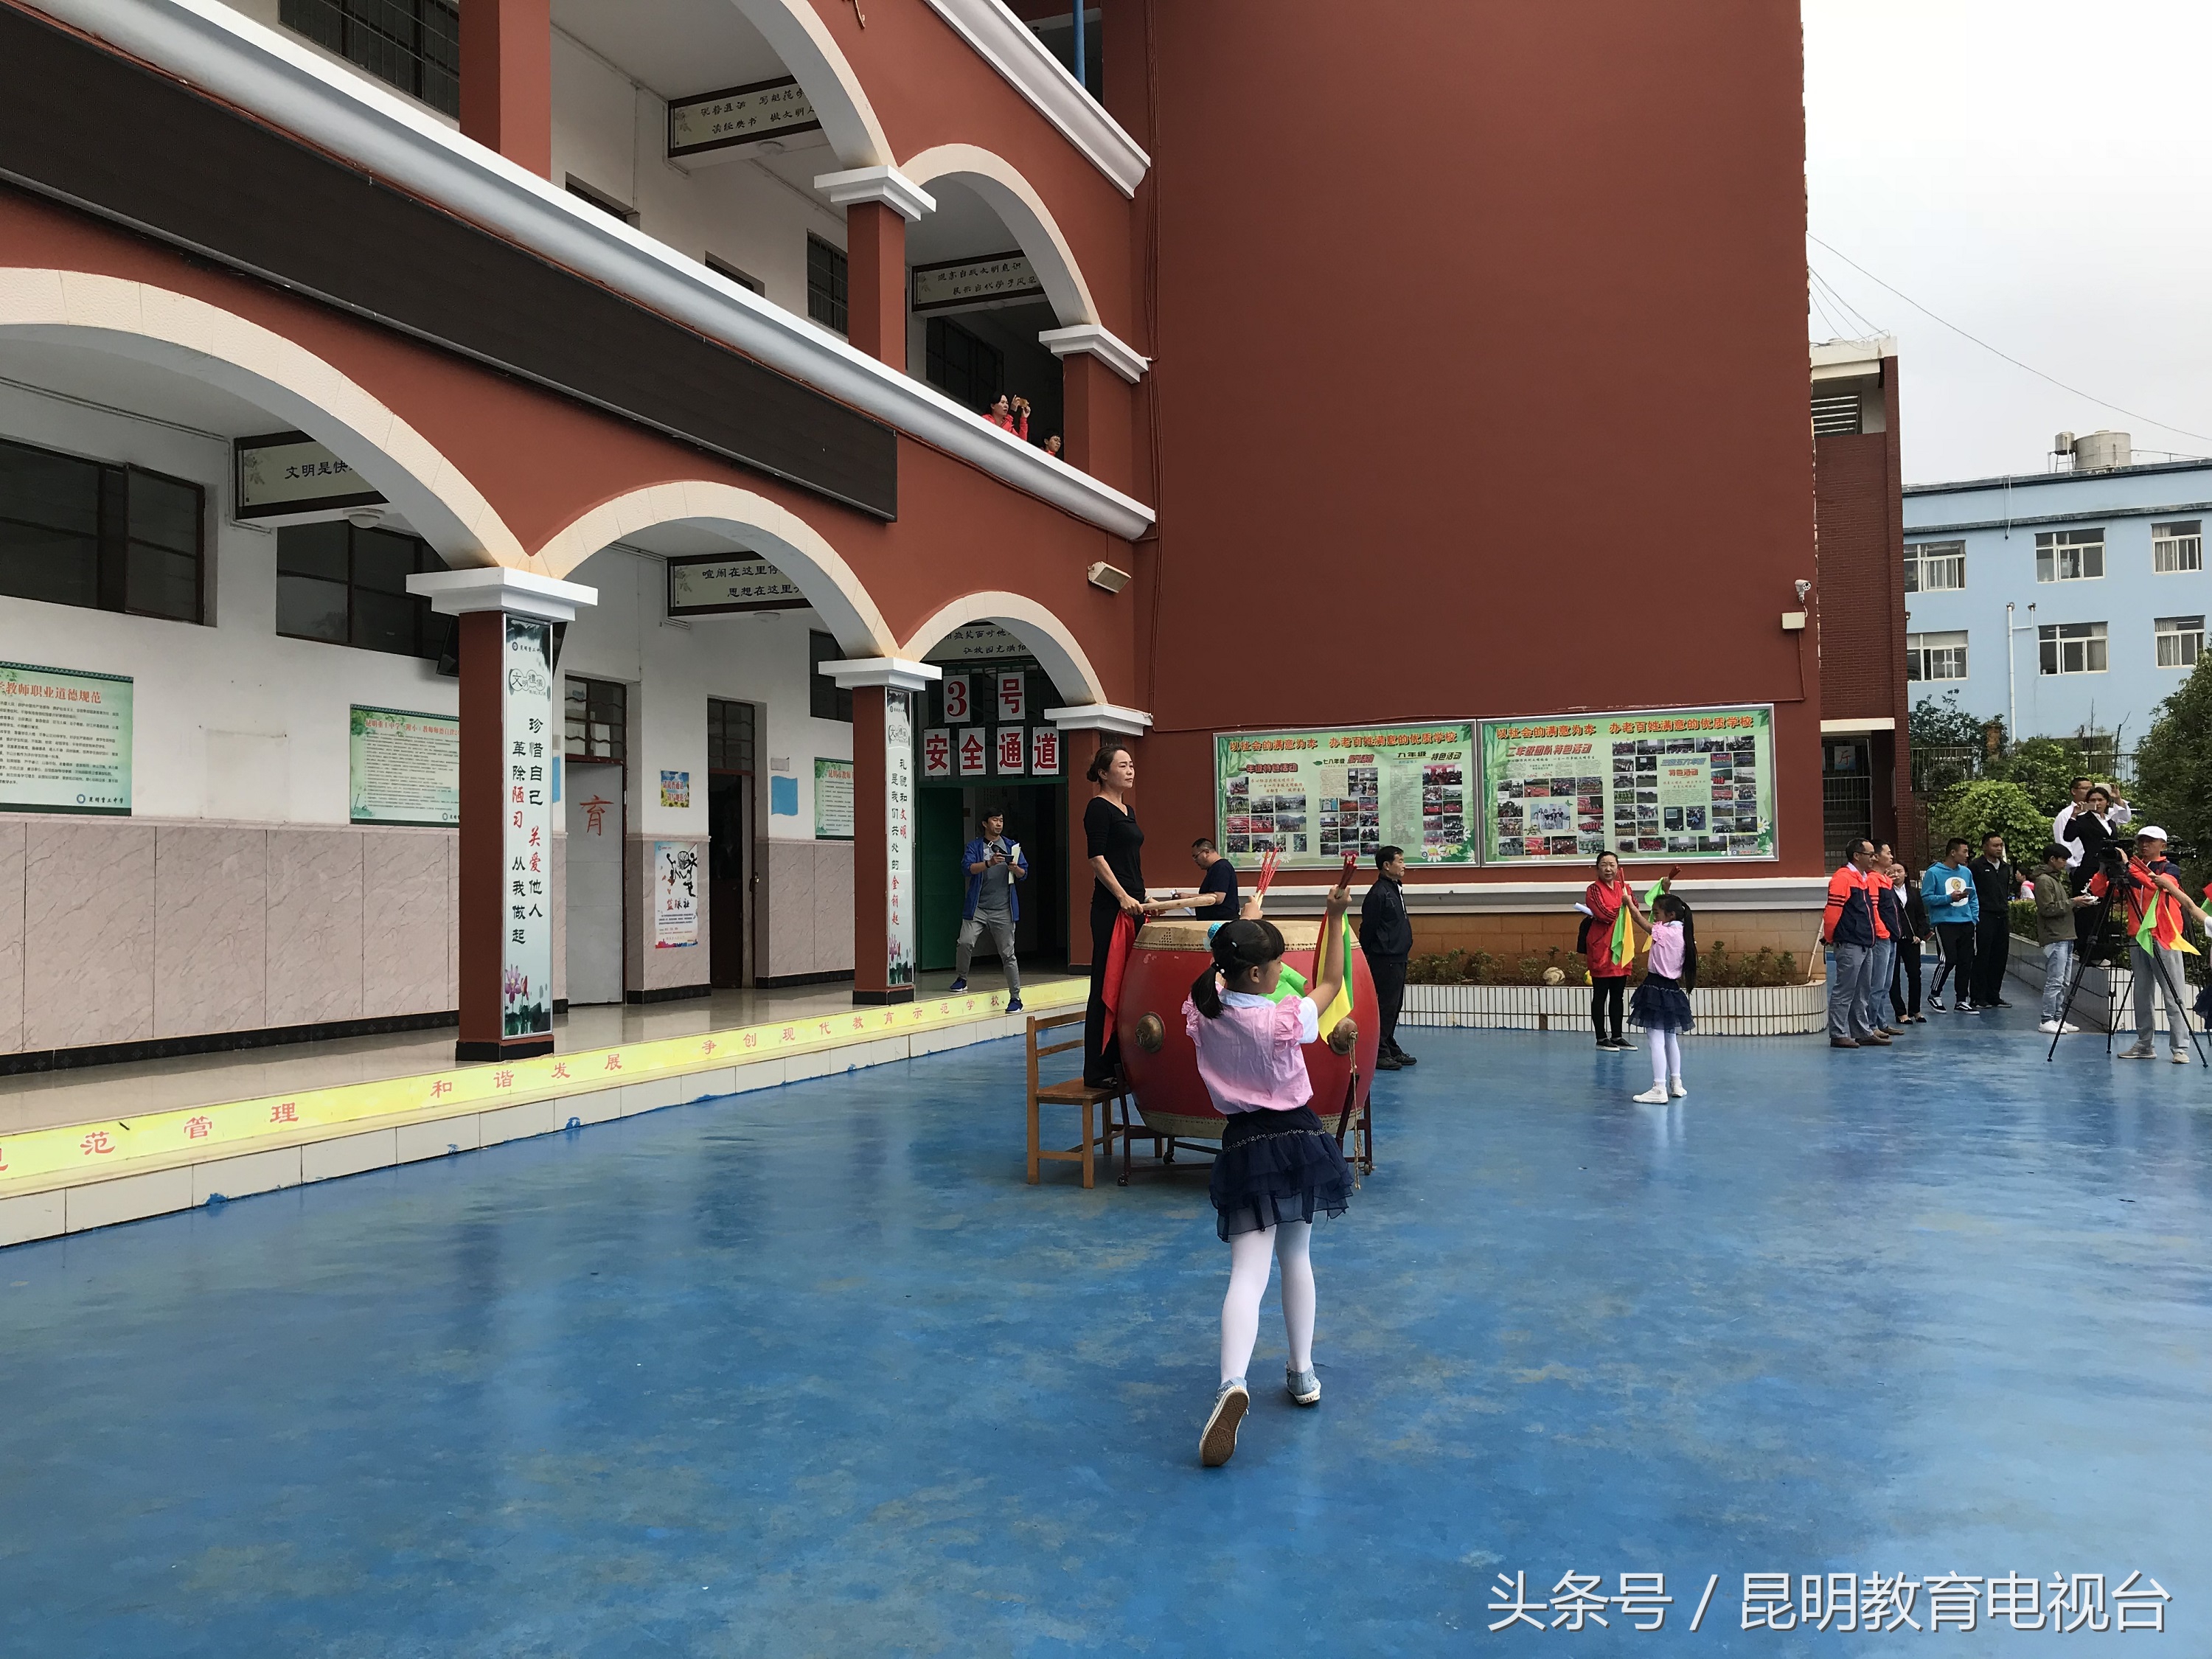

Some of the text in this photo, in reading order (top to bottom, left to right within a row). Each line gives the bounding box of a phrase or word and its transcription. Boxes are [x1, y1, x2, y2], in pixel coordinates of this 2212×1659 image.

[285, 460, 353, 479] 文明是快
[1229, 731, 1458, 753] 以社会的满意为本 办老百姓满意的优质学校
[1496, 715, 1754, 740] 以社会的满意为本 办老百姓满意的优质学校
[925, 732, 1057, 771] 安全通道
[1237, 762, 1298, 773] 一年级特色活动
[1431, 752, 1462, 760] 特色活动
[529, 717, 543, 918] 珍惜自己 关爱他人
[579, 794, 614, 837] 育
[512, 740, 526, 945] 革除陋习 从我做起
[430, 1053, 622, 1098] 和谐发展
[701, 995, 1001, 1054] 争创现代教育示范学校
